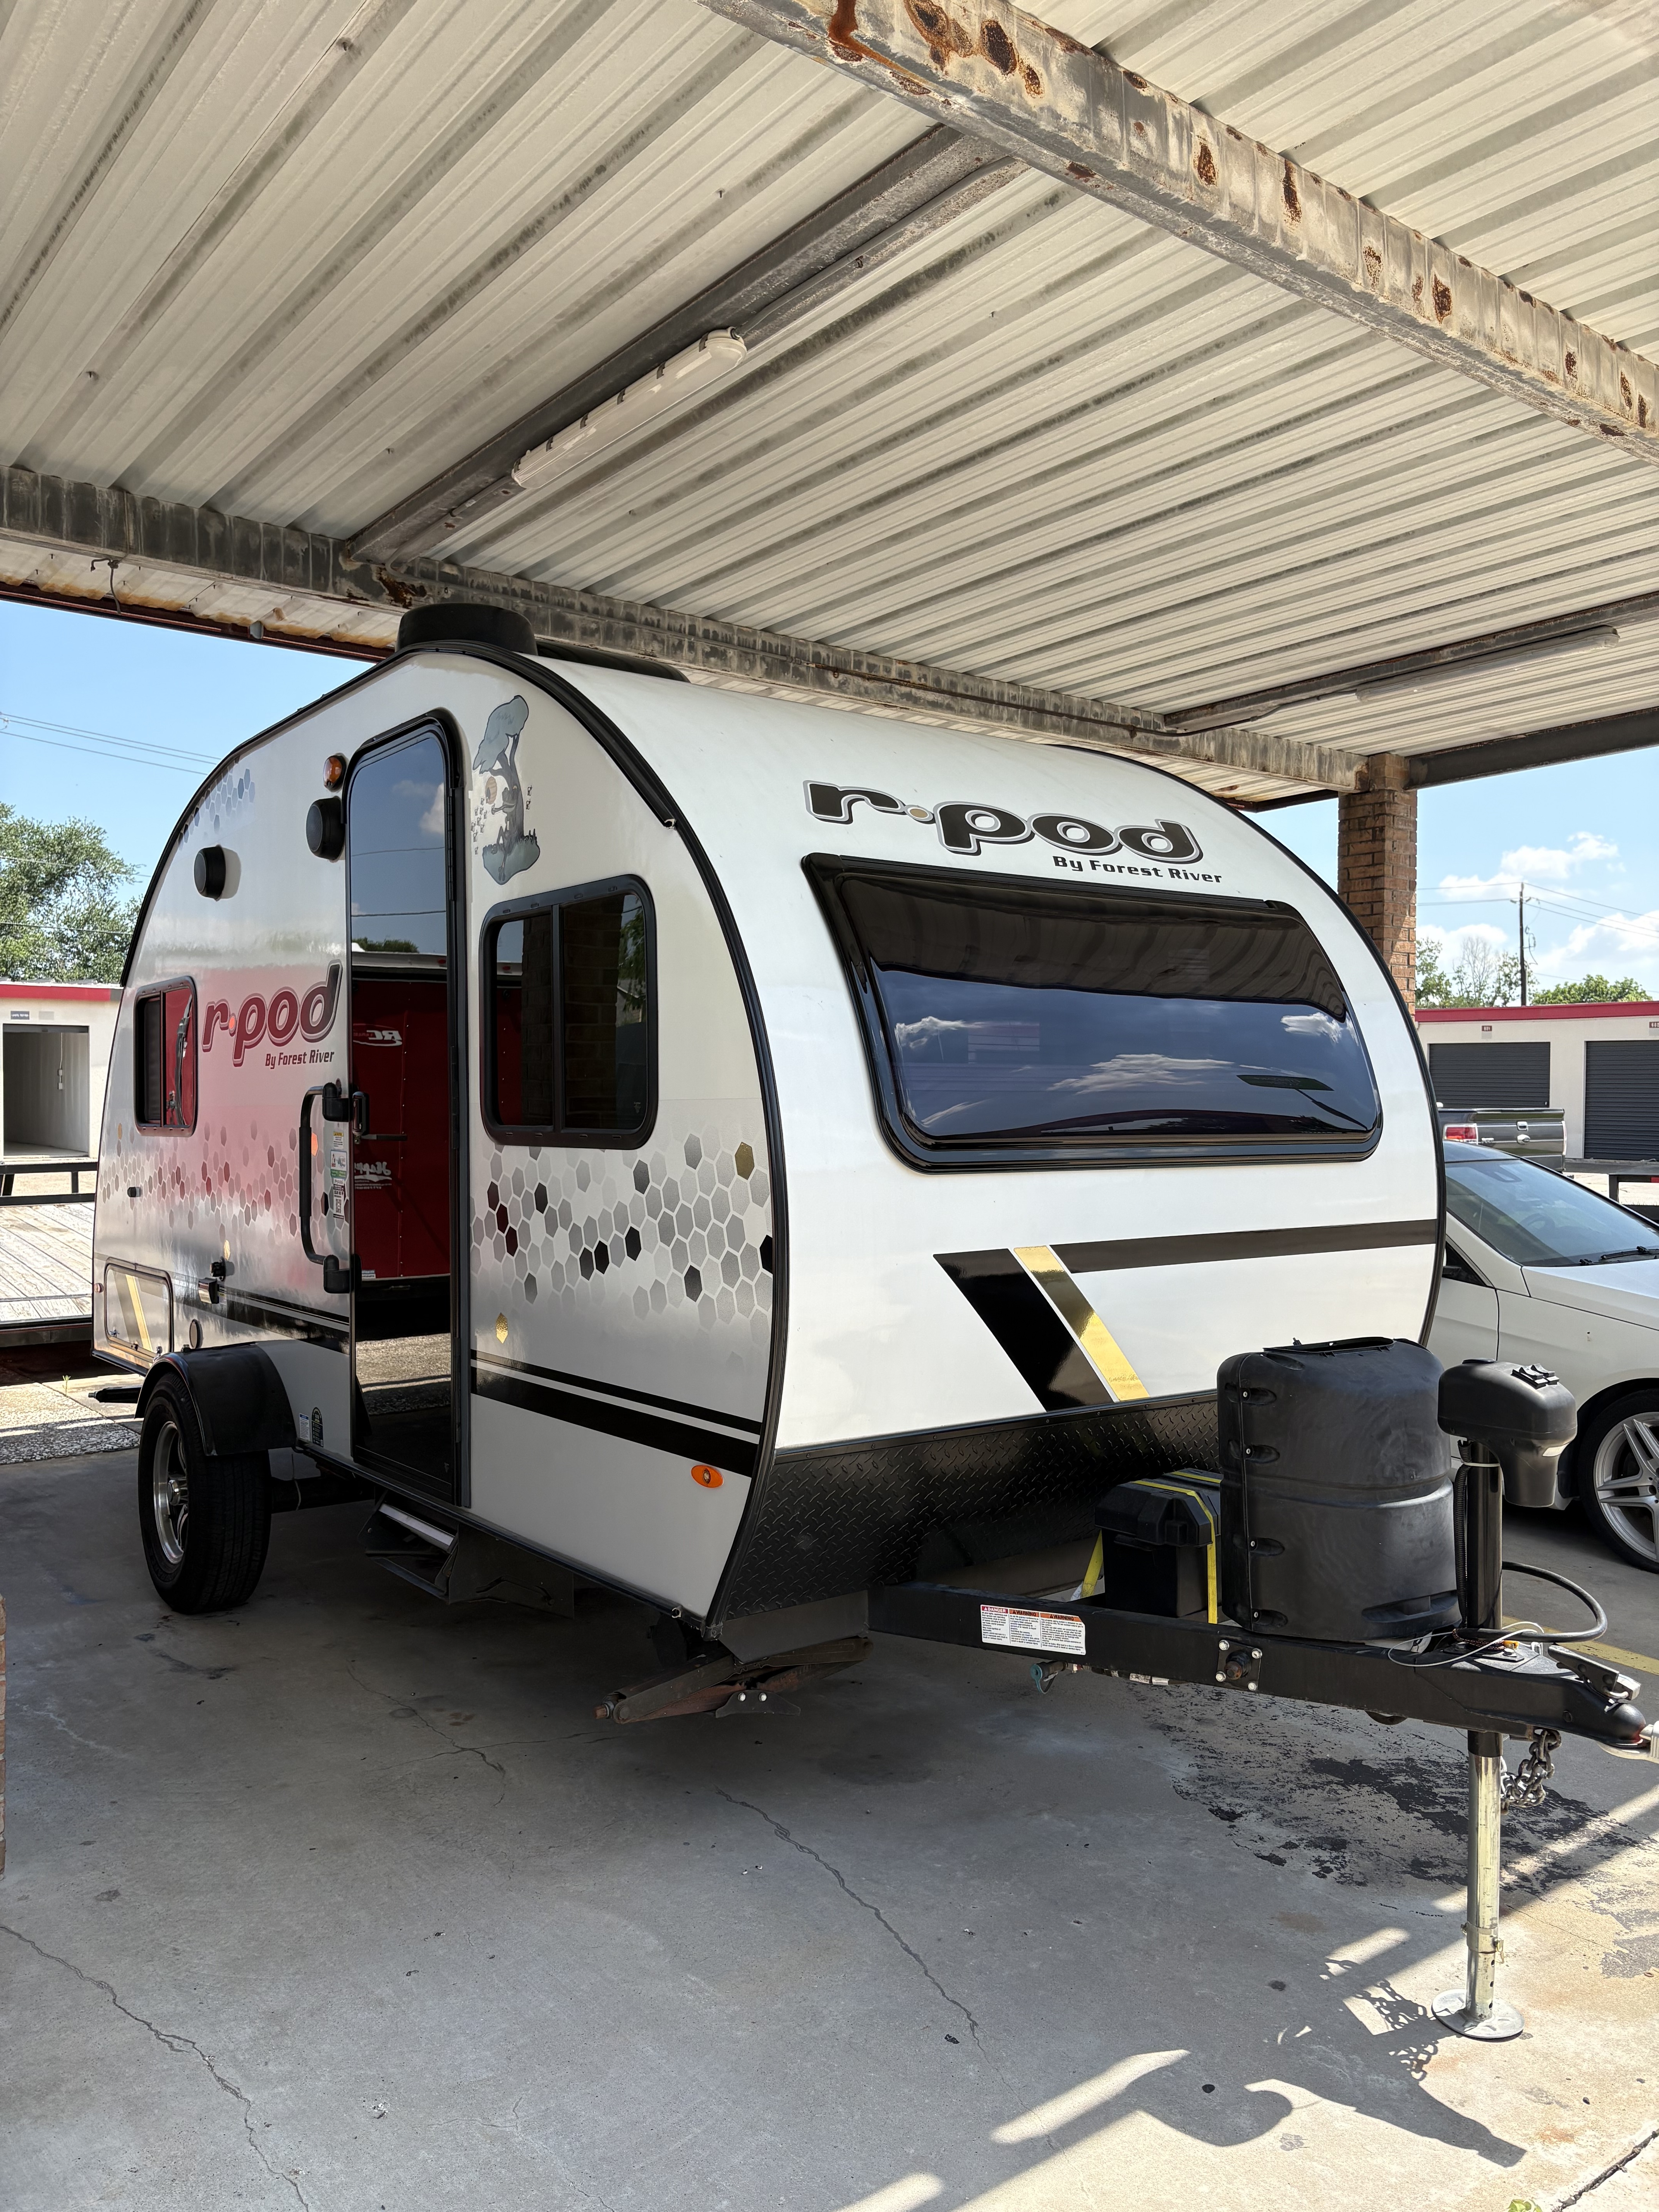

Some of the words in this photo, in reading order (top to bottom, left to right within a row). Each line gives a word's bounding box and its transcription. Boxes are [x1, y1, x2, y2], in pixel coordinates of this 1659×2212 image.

[1053, 856, 1083, 872] By
[1089, 860, 1163, 877] Forest
[1168, 868, 1222, 883] River
[265, 1053, 276, 1069] By
[278, 1052, 307, 1065] Forest
[309, 1049, 335, 1063] River
